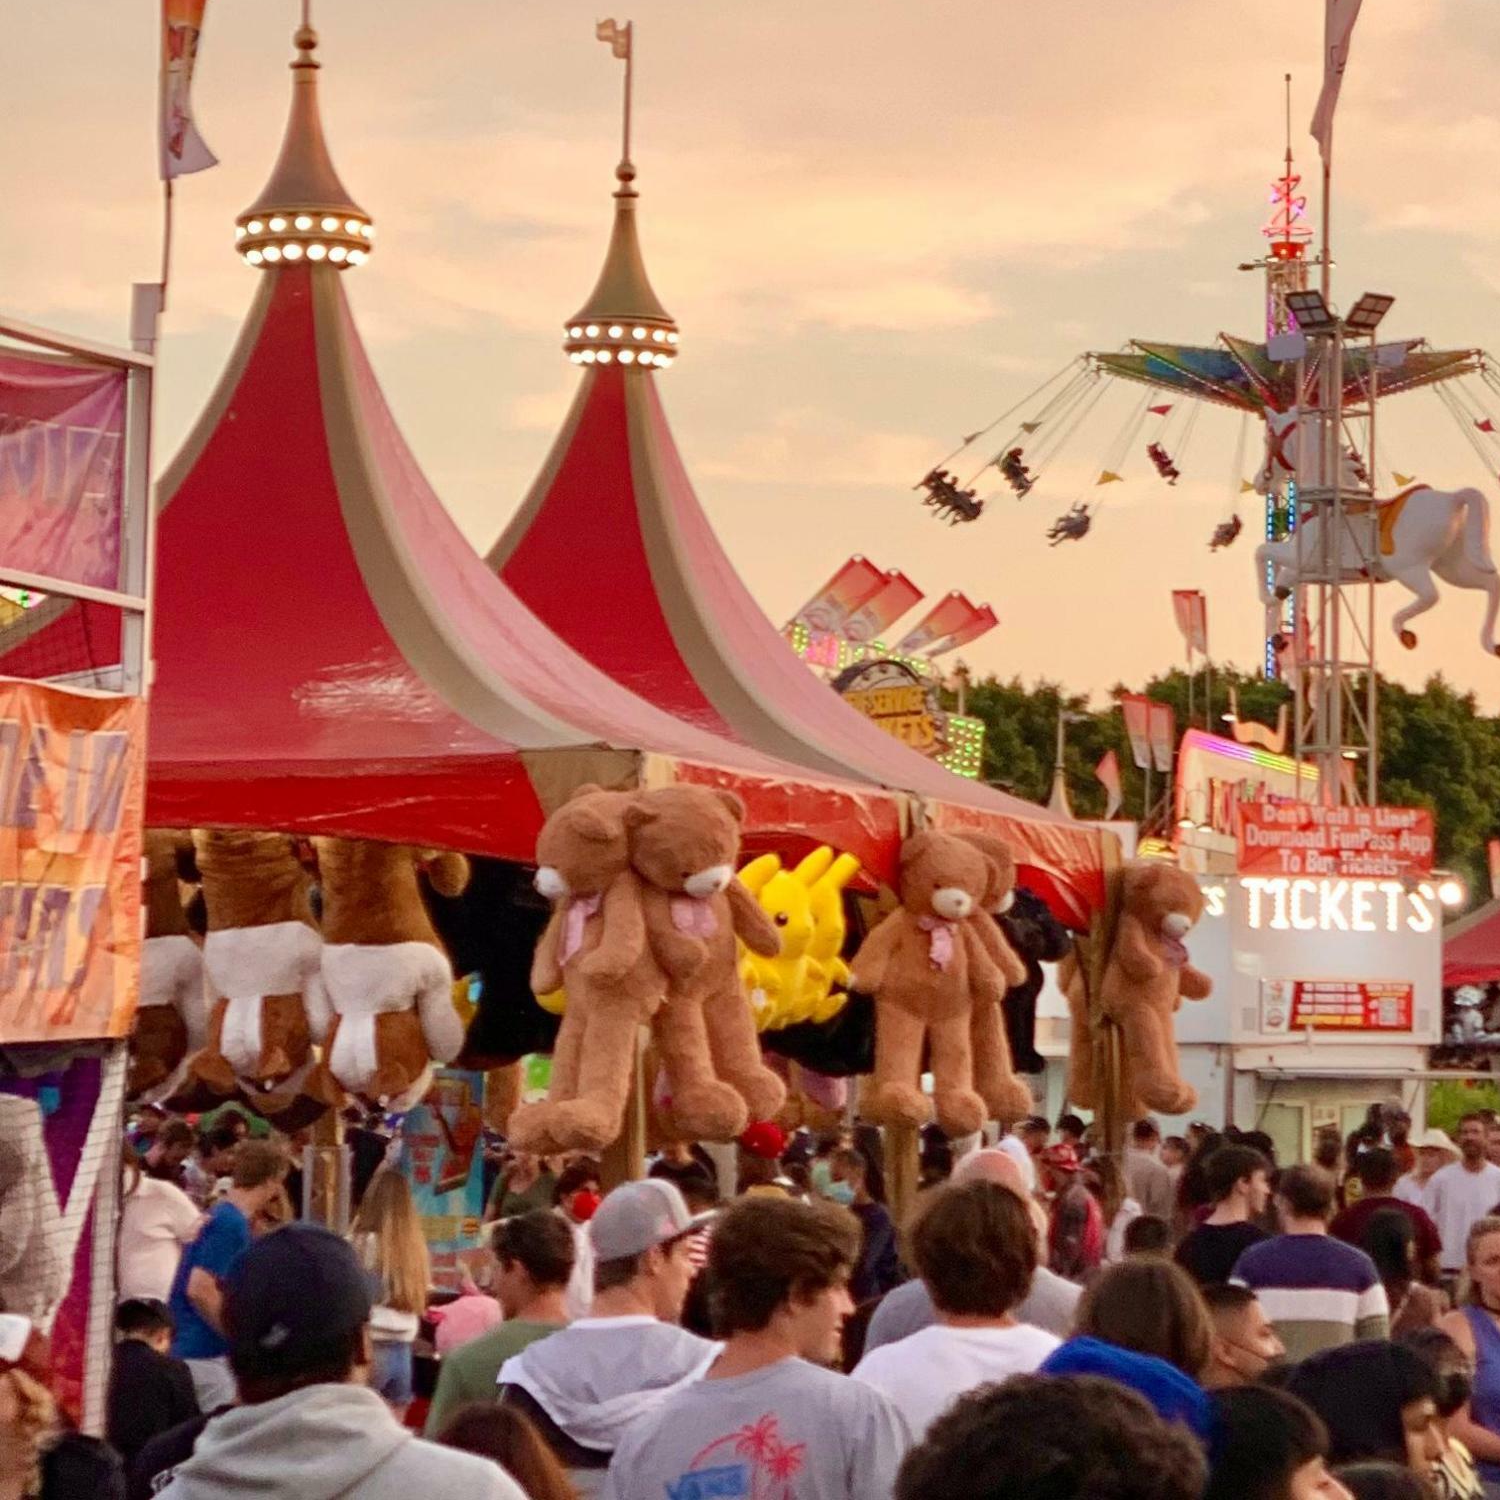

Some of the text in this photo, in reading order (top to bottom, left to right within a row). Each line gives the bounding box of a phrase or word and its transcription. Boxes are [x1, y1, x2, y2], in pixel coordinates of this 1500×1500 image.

[1262, 803, 1308, 824] Don't
[1311, 805, 1349, 825] Wait
[1354, 808, 1371, 826] in
[1246, 824, 1432, 857] Download FunPass App
[1279, 849, 1399, 877] To Buy Tickets
[1240, 877, 1435, 933] TICKETS
